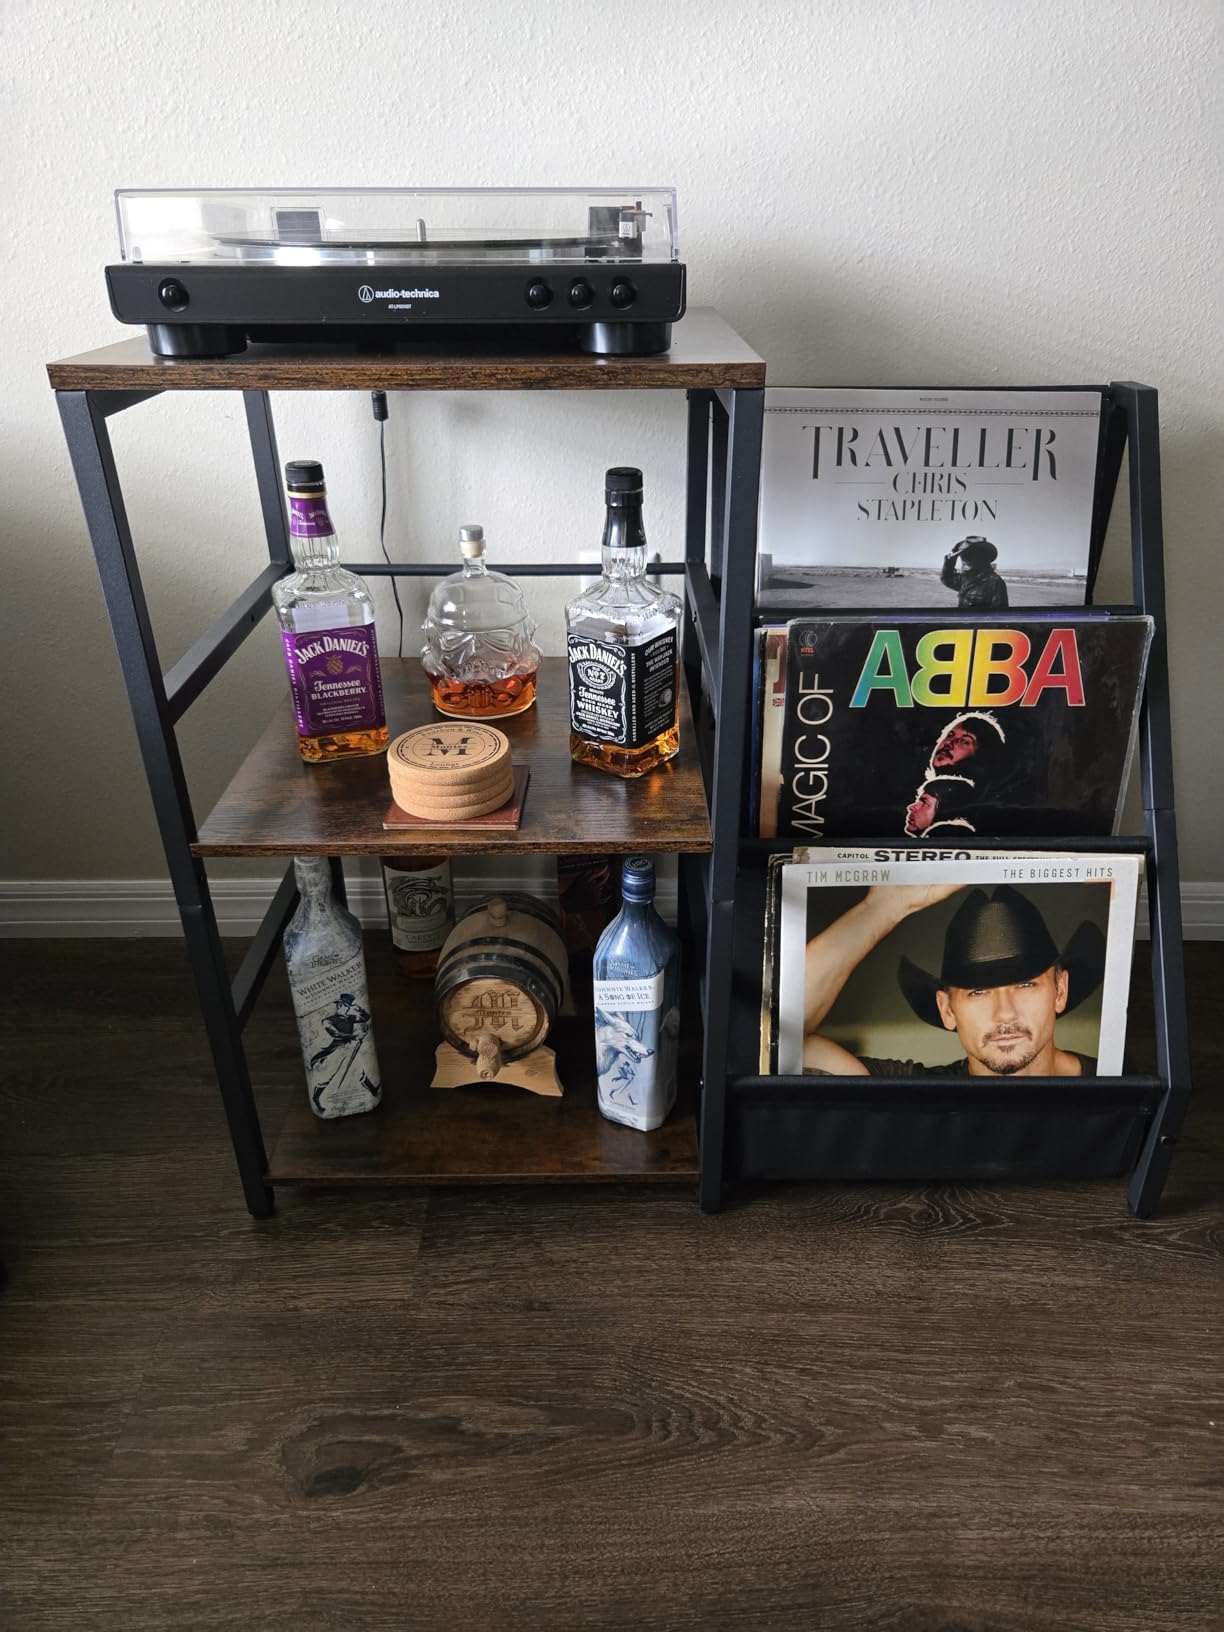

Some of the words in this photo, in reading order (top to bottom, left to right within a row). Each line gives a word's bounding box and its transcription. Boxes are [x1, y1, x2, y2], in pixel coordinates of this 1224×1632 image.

[374, 288, 440, 299] audio-technica
[802, 425, 1058, 482] TRAVELLER
[892, 471, 968, 495] CHRIS
[857, 498, 998, 522] STAPLETON
[294, 641, 326, 665] JACK
[323, 636, 370, 658] DANIEL'S
[568, 646, 588, 664] JACK
[588, 643, 628, 677] DANIEL'S
[849, 628, 1087, 708] ABBA
[311, 686, 367, 701] BLACKBERRY
[313, 679, 362, 692] Tennessee
[578, 686, 617, 705] Tennessee
[796, 671, 834, 726] OF
[576, 699, 620, 720] WHISKEY
[836, 852, 870, 860] CAPITOL
[873, 850, 972, 862] STEREO
[806, 870, 828, 884] TIM
[835, 869, 892, 883] MCGRAW
[1003, 868, 1025, 879] THE
[1030, 867, 1081, 879] BIGGEST
[1086, 866, 1114, 878] HITS
[297, 979, 328, 997] WHITE
[326, 962, 362, 983] WALKER
[604, 992, 625, 1001] SONG
[636, 992, 649, 1000] ICE
